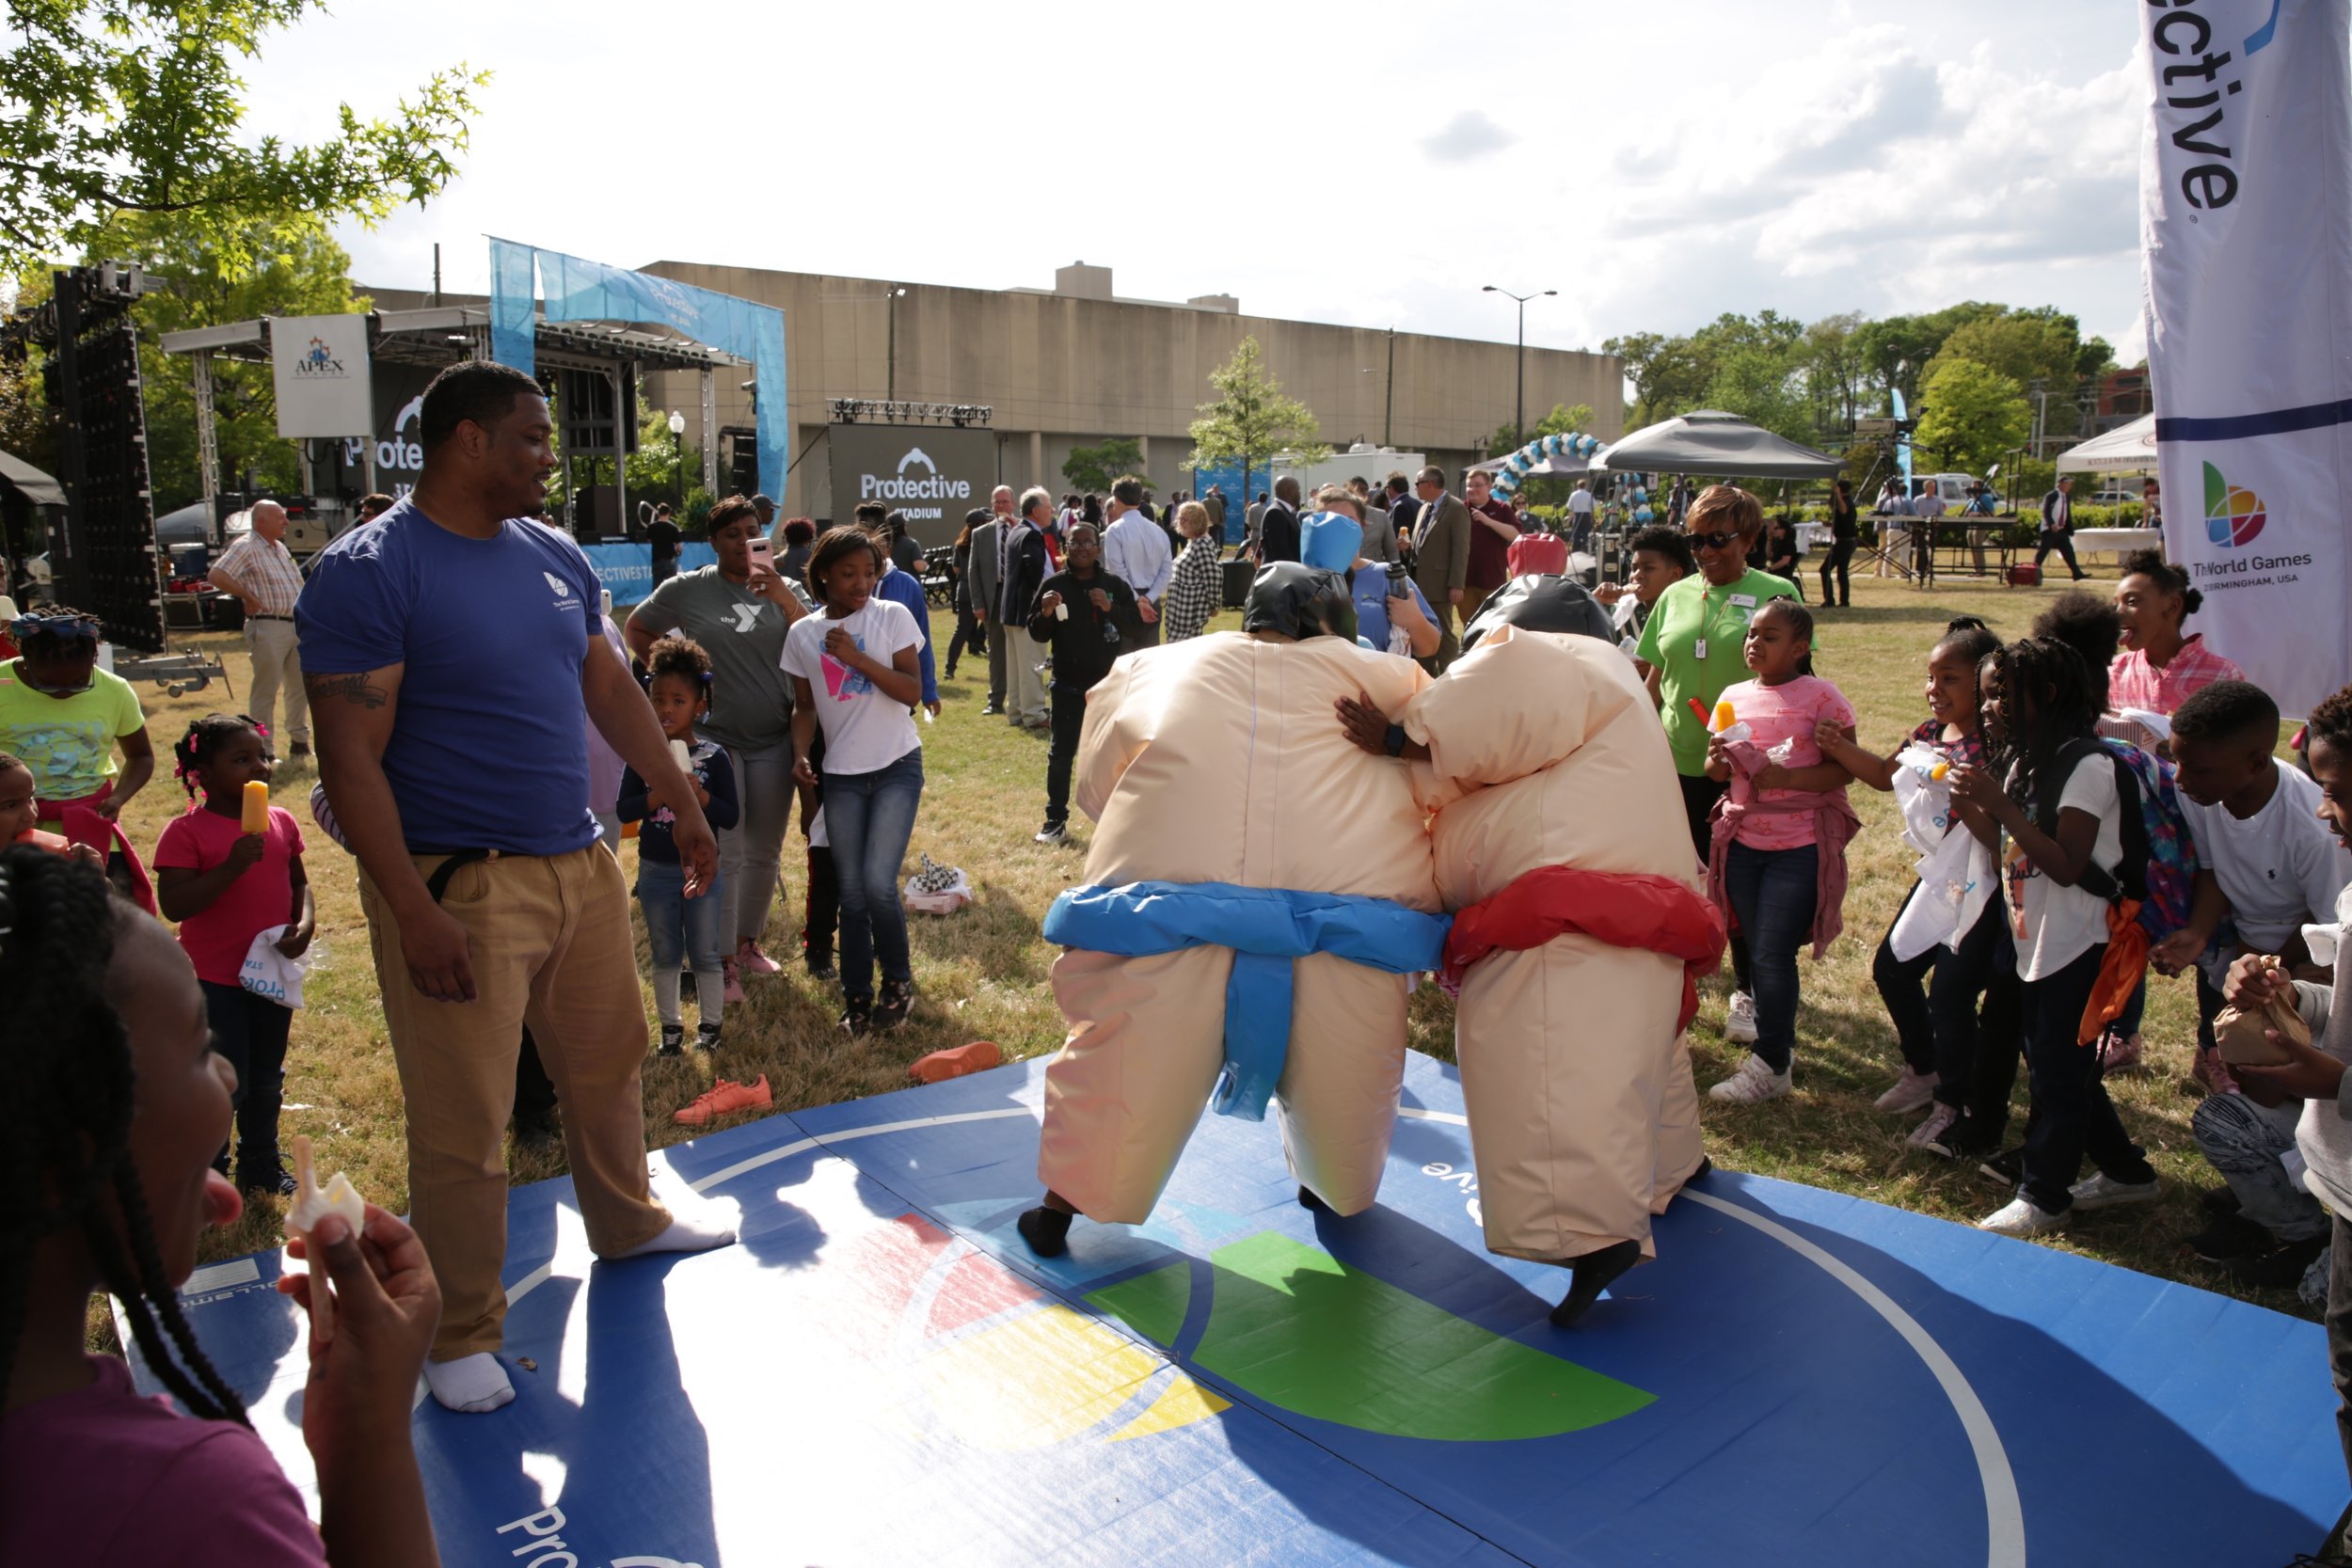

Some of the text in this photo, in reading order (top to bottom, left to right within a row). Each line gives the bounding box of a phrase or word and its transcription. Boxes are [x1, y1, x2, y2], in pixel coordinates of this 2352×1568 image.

[2146, 0, 2242, 209] ctive
[295, 359, 344, 372] APEX
[861, 474, 971, 499] Protective
[2252, 554, 2312, 571] Games
[2278, 575, 2299, 584] USA
